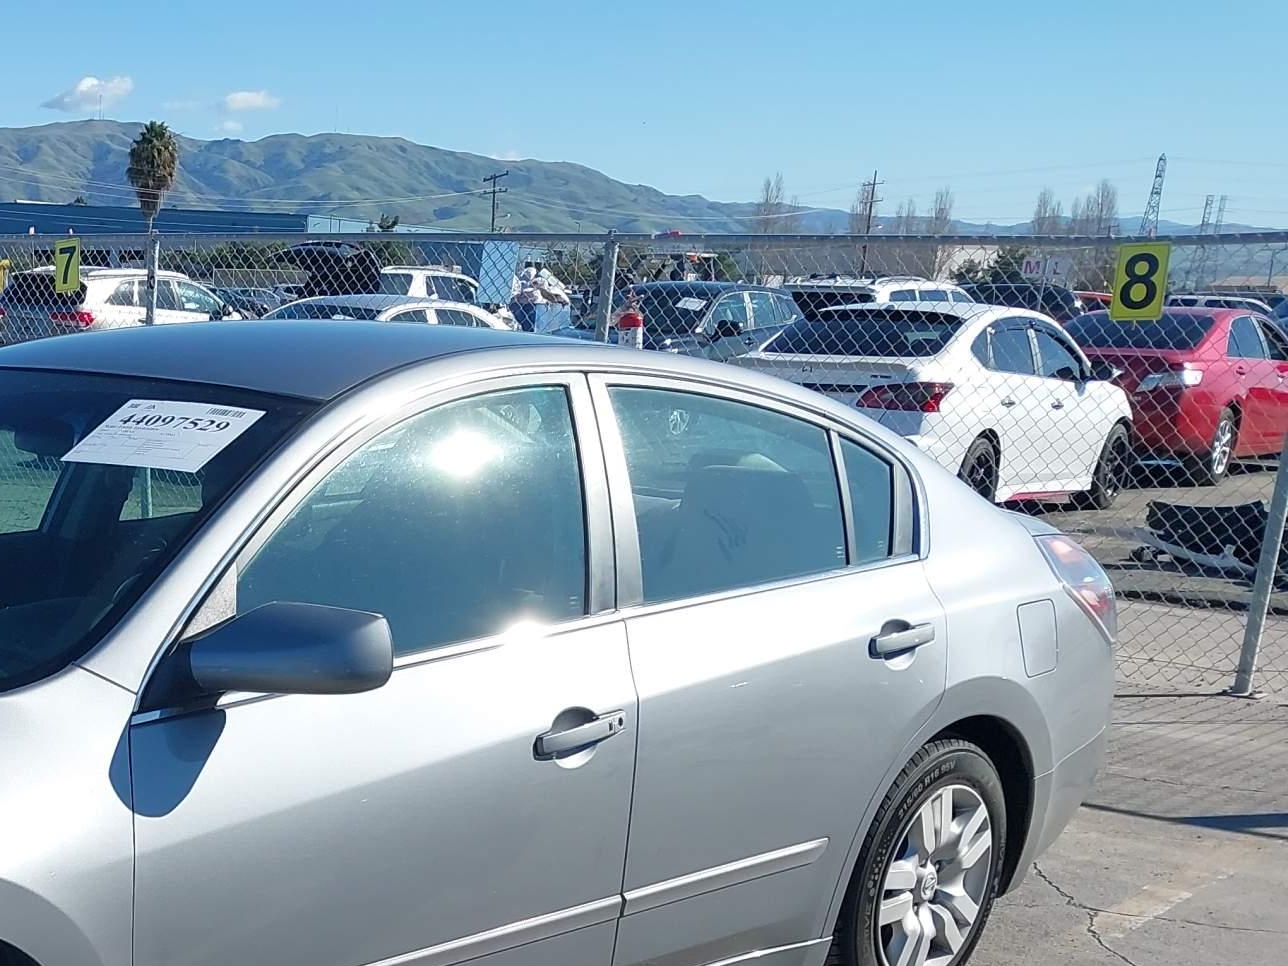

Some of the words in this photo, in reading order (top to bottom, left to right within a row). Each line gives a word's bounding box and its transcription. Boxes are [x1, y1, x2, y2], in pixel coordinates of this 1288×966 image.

[59, 246, 76, 284] 7
[1119, 252, 1160, 310] 8
[120, 413, 230, 433] 44097529
